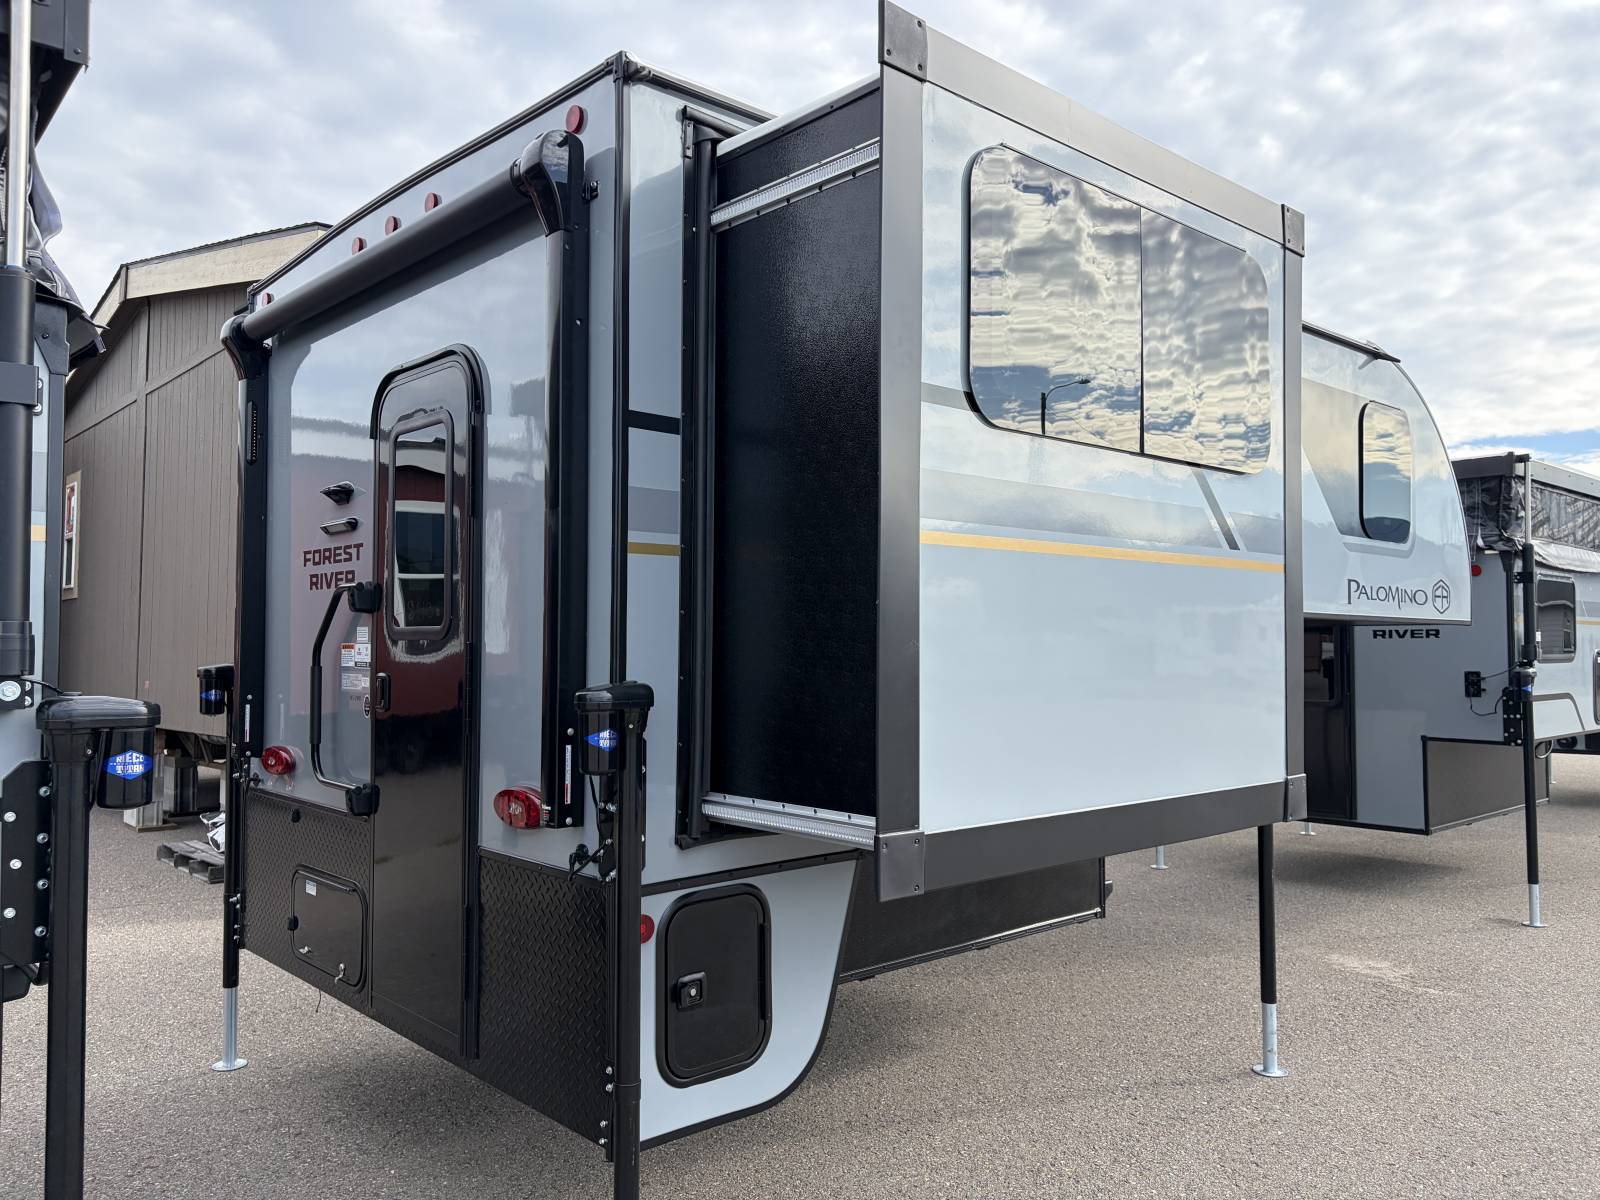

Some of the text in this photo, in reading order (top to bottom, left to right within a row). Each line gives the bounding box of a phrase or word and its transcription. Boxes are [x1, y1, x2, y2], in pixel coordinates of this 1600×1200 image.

[303, 543, 364, 567] FOREST
[309, 570, 356, 591] RIVER
[1372, 628, 1441, 640] RIVER
